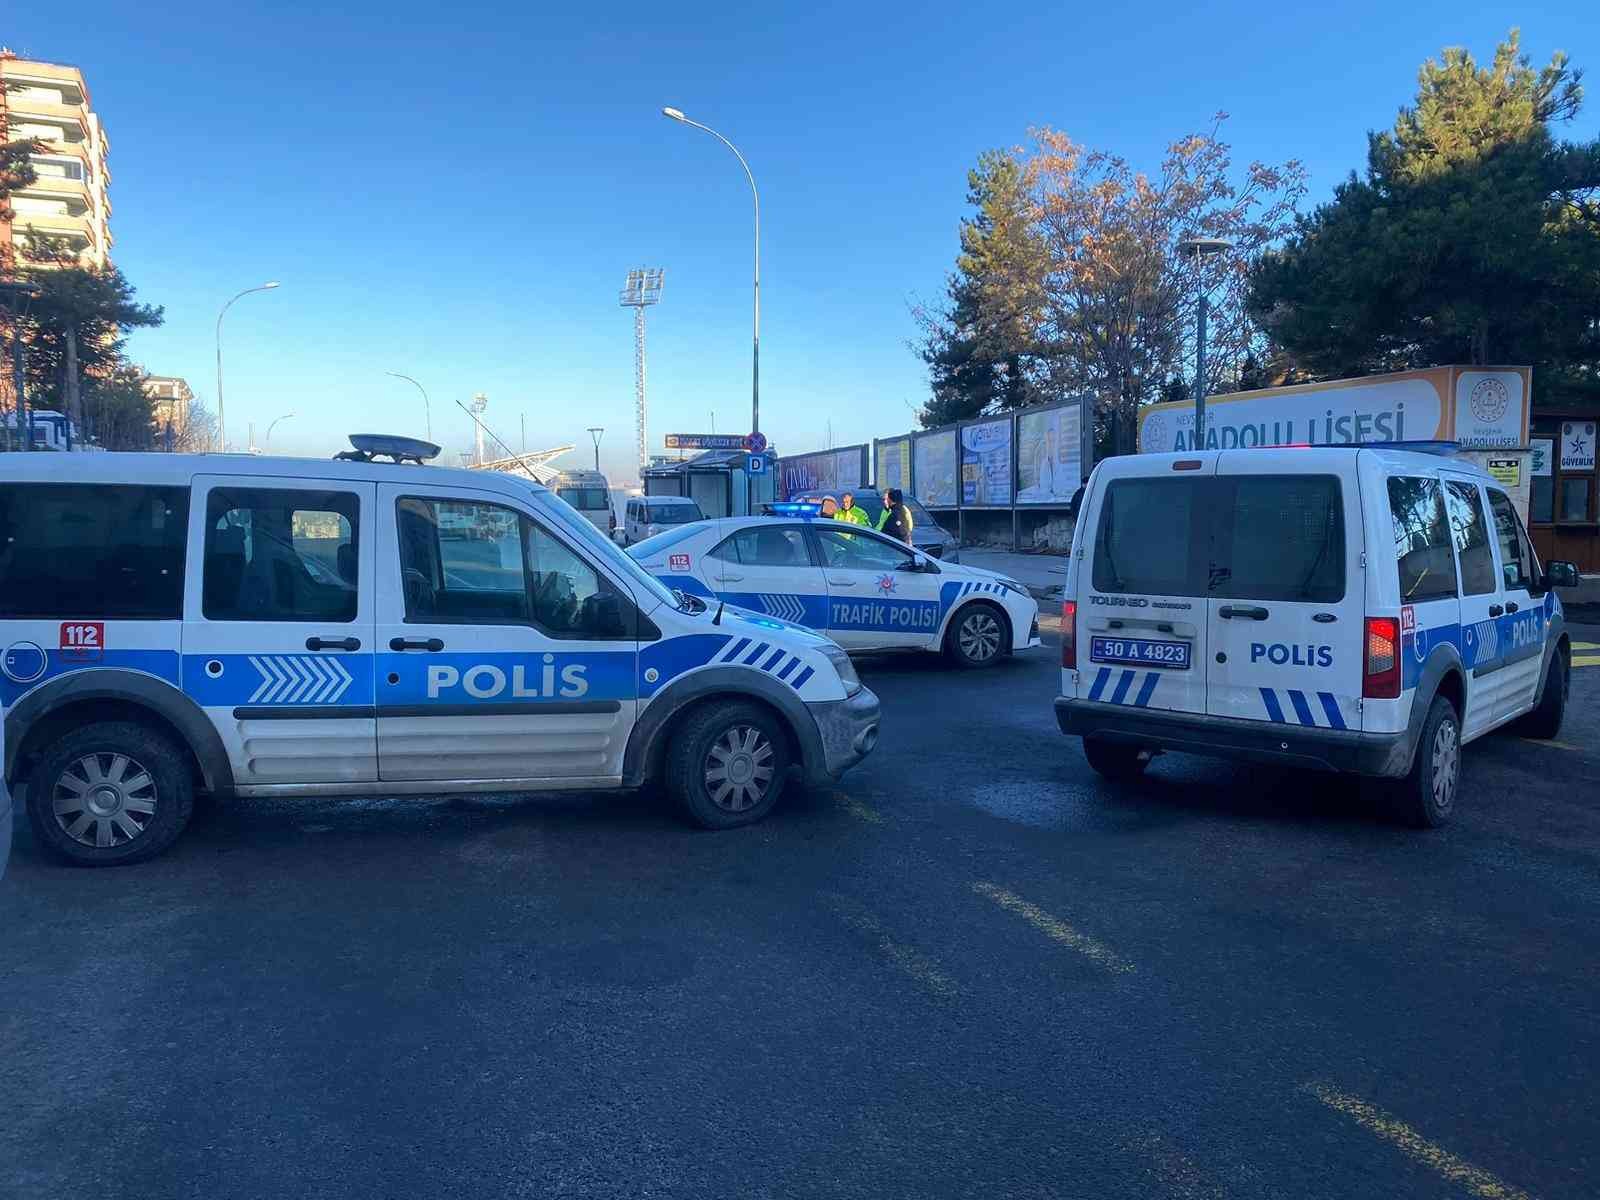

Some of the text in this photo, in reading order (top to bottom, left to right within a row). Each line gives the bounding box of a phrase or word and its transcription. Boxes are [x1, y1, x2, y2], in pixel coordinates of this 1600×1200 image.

[1308, 402, 1404, 445] LİSESİ
[751, 459, 761, 470] D
[1561, 454, 1594, 466] GÜVENLİK
[672, 556, 688, 564] 112
[832, 602, 938, 628] TRAFİK POLİSİ
[1402, 608, 1414, 629] 112
[66, 625, 98, 645] 112
[1512, 610, 1539, 649] POLİS
[1105, 642, 1185, 662] 50 A 4823
[1250, 642, 1333, 668] POLİS
[426, 653, 589, 699] POLİS
